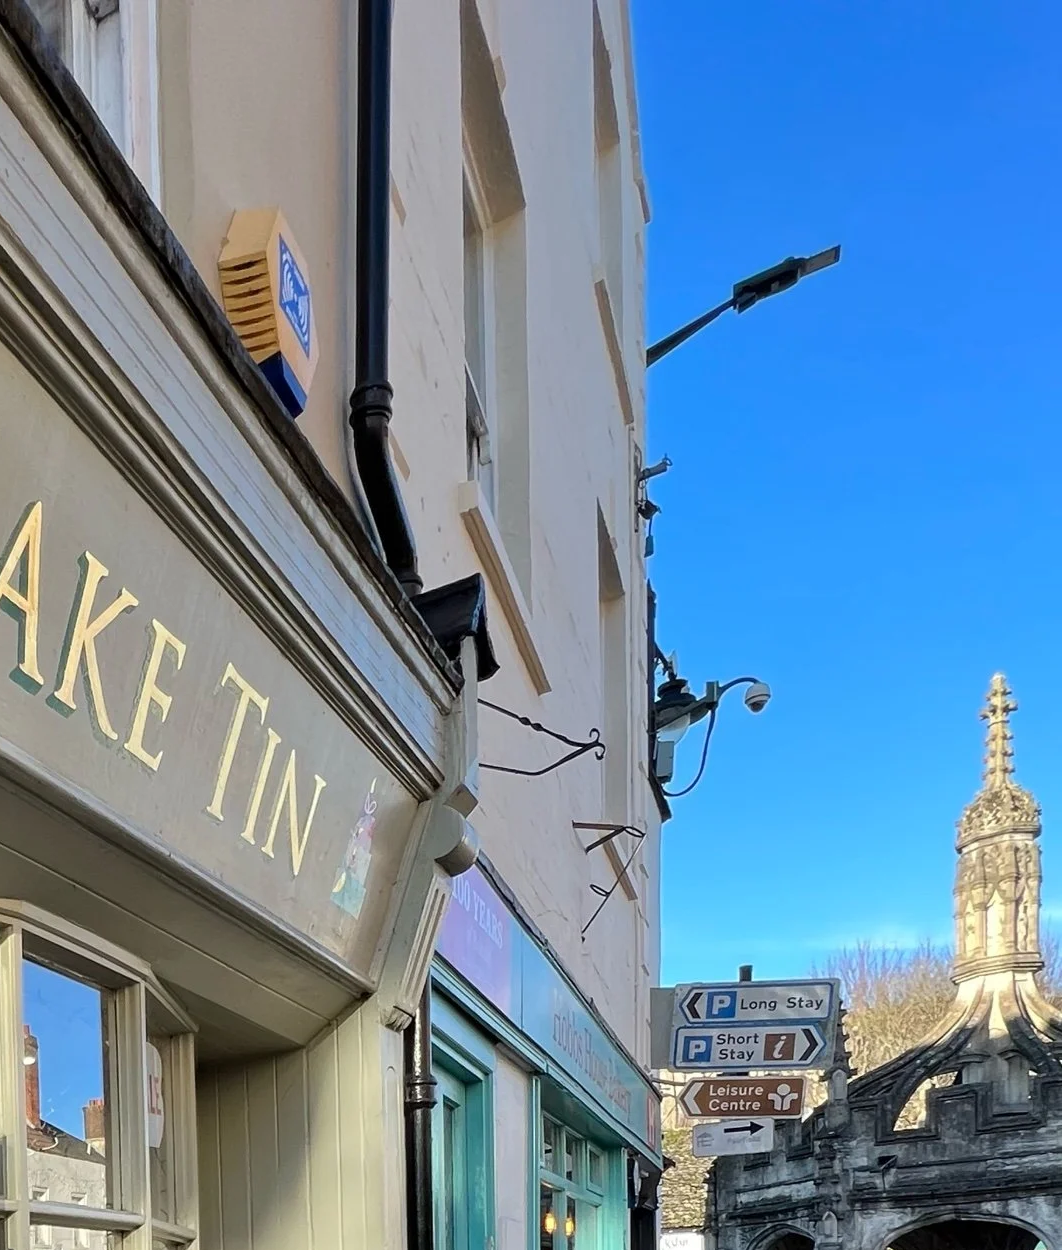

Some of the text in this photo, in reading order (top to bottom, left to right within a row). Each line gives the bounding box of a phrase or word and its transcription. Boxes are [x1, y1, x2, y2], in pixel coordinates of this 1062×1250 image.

[206, 662, 327, 877] TIN
[473, 889, 503, 950] YEARS
[740, 998, 777, 1011] Long
[786, 997, 824, 1010] Stay
[716, 1034, 759, 1045] Short
[718, 1049, 754, 1061] Stay
[709, 1084, 764, 1096] Leisure
[708, 1099, 761, 1111] Centre
